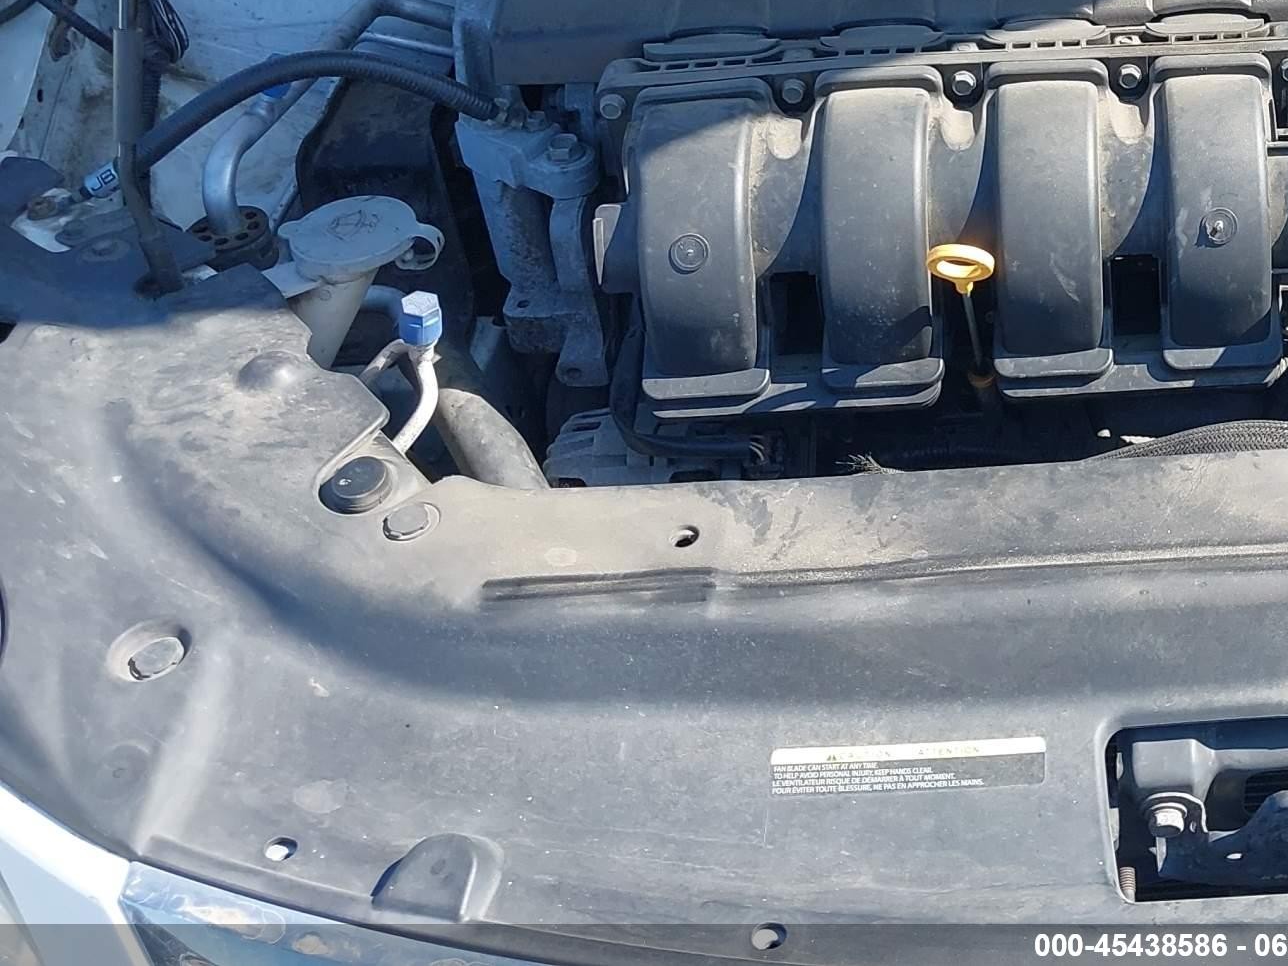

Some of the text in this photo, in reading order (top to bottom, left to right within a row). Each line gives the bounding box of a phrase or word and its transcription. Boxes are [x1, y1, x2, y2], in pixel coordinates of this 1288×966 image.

[773, 772, 783, 780] TO
[799, 771, 819, 779] AVOID
[819, 770, 849, 778] PERSONAL
[874, 768, 890, 776] KEEP
[890, 767, 912, 775] HANDS
[787, 764, 807, 772] BLADE
[822, 763, 840, 771] START
[840, 762, 850, 770] AT
[771, 786, 791, 794] POUR
[815, 785, 836, 793] TOUTE
[873, 783, 883, 791] NE
[907, 780, 949, 789] APPROCHER
[948, 778, 961, 787] LES
[960, 778, 984, 786] MAINS.
[772, 779, 781, 787] LE
[781, 778, 826, 787] VENTILATEUR
[826, 777, 851, 785] RISQUE
[851, 776, 861, 784] DE
[905, 773, 924, 781] TOUT
